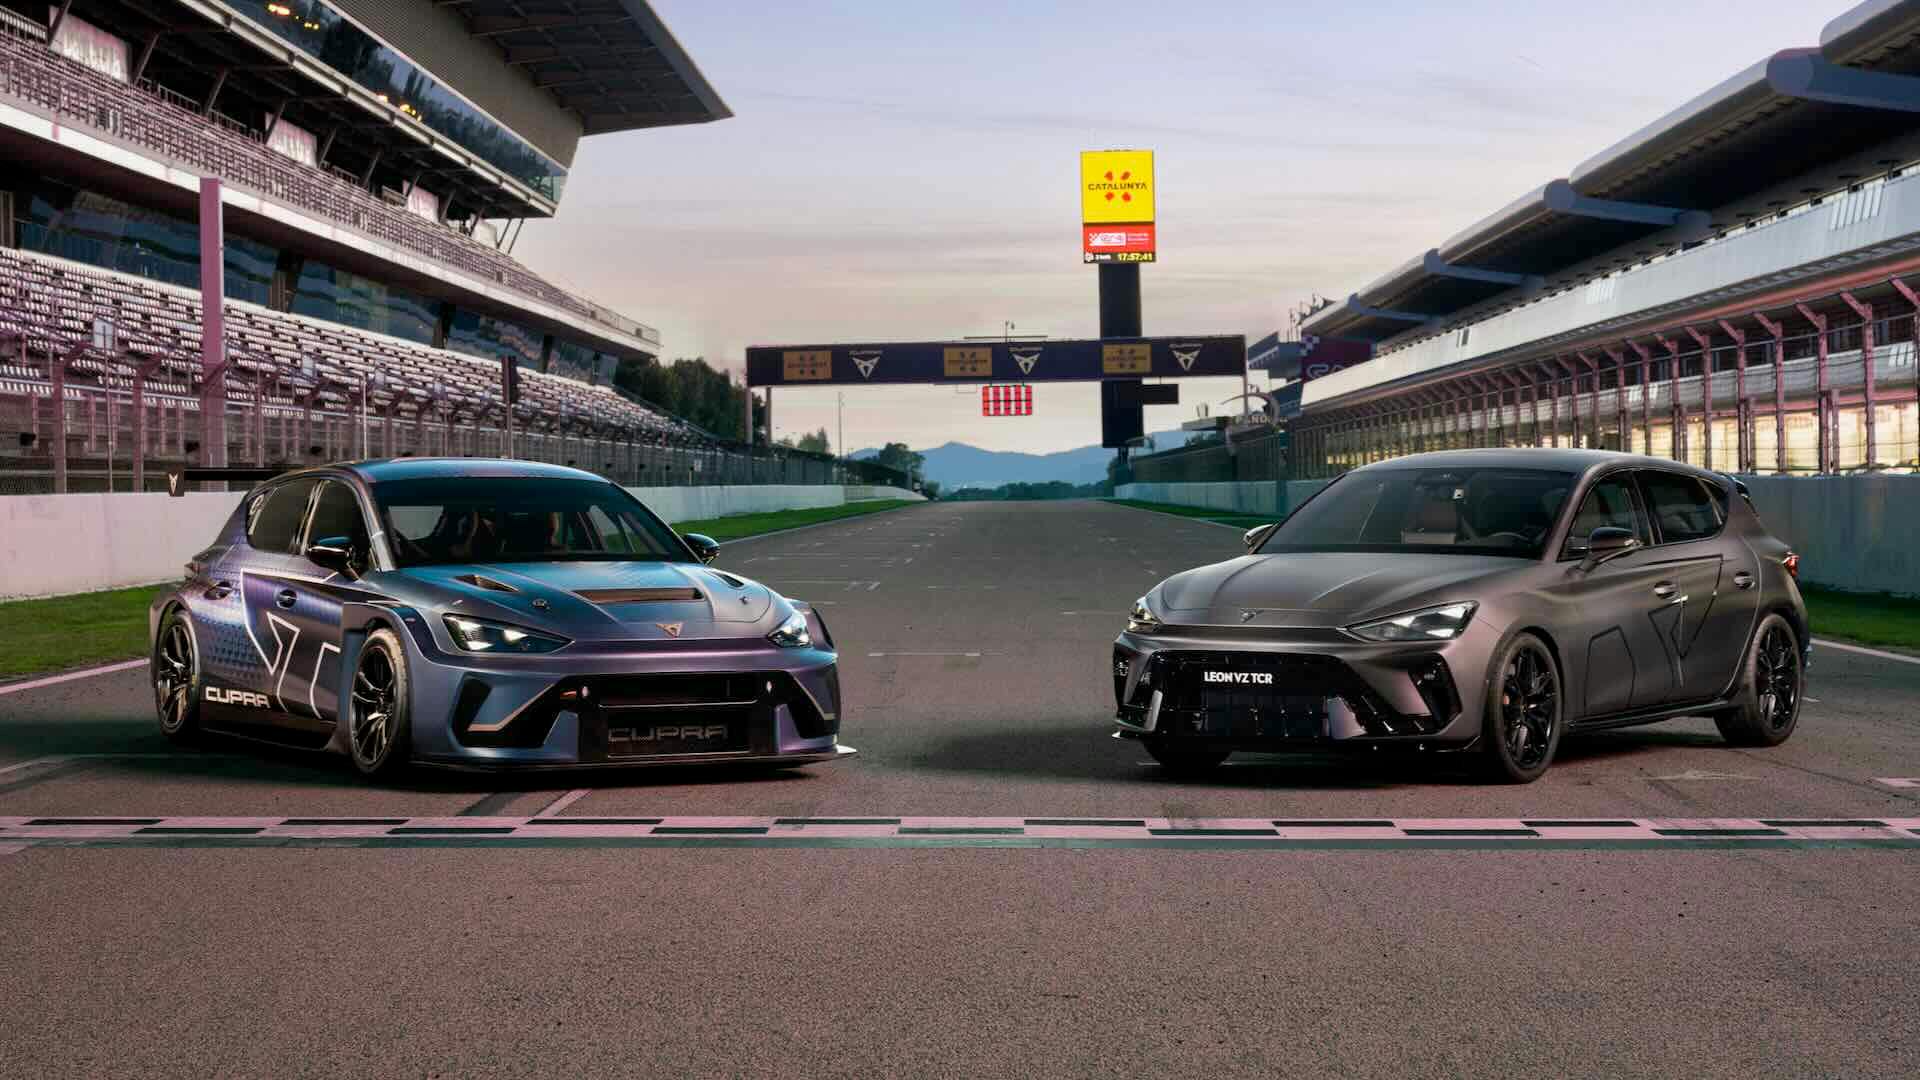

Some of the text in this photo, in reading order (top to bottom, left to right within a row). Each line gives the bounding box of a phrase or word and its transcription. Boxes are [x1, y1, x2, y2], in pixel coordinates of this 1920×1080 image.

[1088, 182, 1148, 191] CATALUNYA
[1204, 671, 1273, 685] LEON VZ TCR
[205, 686, 271, 709] CUPRA
[607, 725, 729, 742] CUPRA
